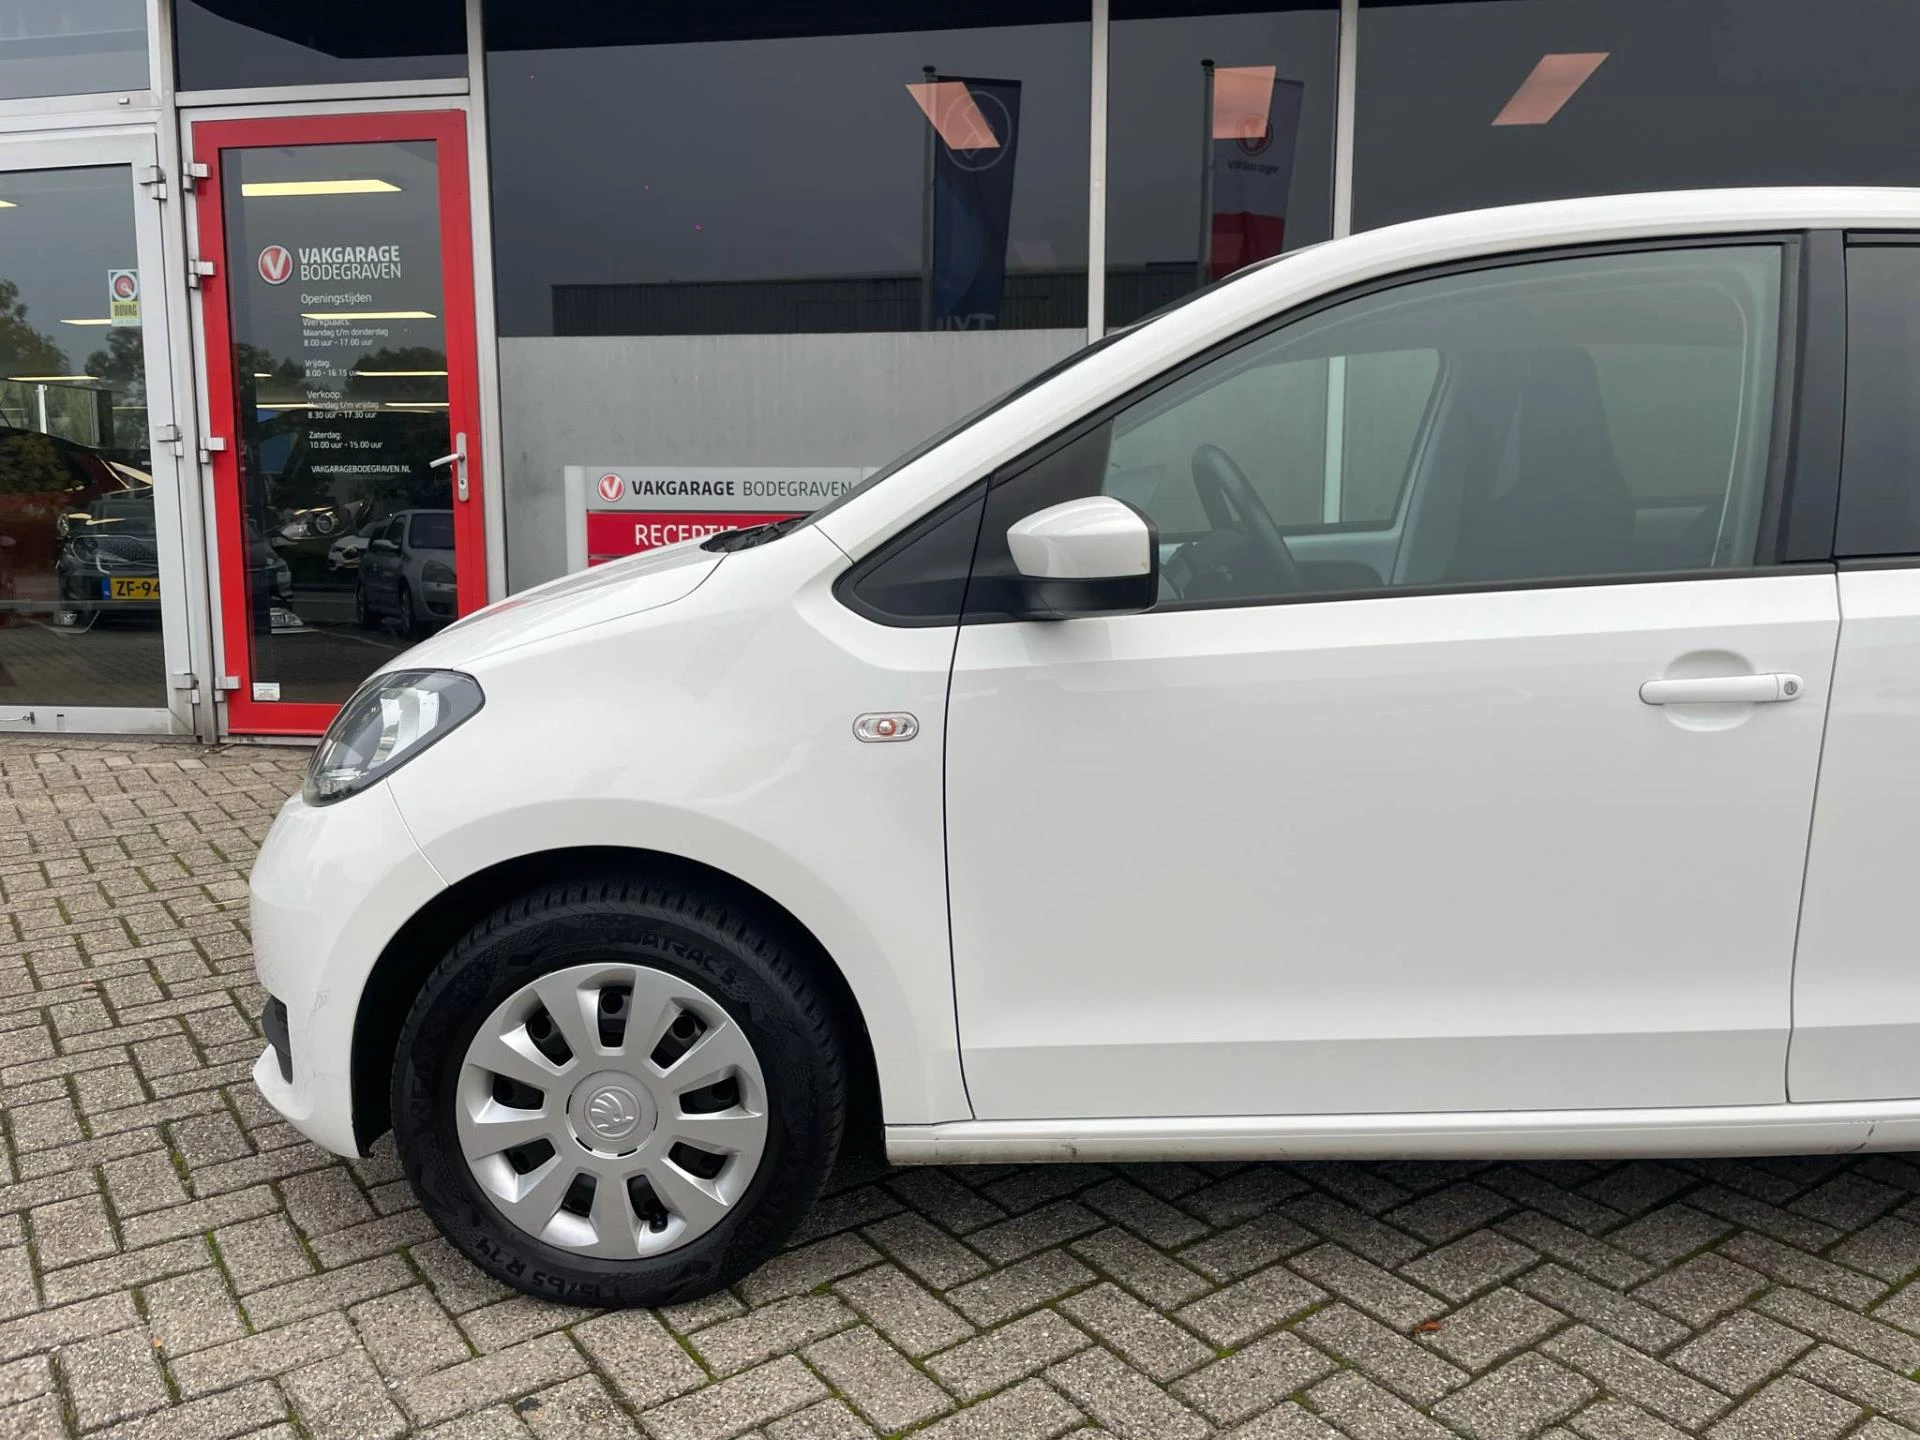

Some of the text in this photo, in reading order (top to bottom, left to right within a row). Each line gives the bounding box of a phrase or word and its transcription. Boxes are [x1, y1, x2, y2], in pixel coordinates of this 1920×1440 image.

[299, 246, 400, 264] VAKGARAGE
[300, 263, 401, 281] BODEGRAVEN
[301, 292, 372, 305] Openingstijden
[114, 304, 138, 317] BOVAG
[303, 328, 389, 338] Maandag t/m donderdag
[308, 411, 324, 419] 8.30
[325, 411, 337, 419] uur
[344, 410, 364, 419] 17.30
[310, 441, 330, 449] 10.00
[311, 464, 411, 473] VAKGARAGEBODEGRAVEN.NL
[632, 480, 735, 496] VAKGARAGE
[743, 480, 852, 497] BODEGRAVEN
[634, 524, 738, 546] RECEP
